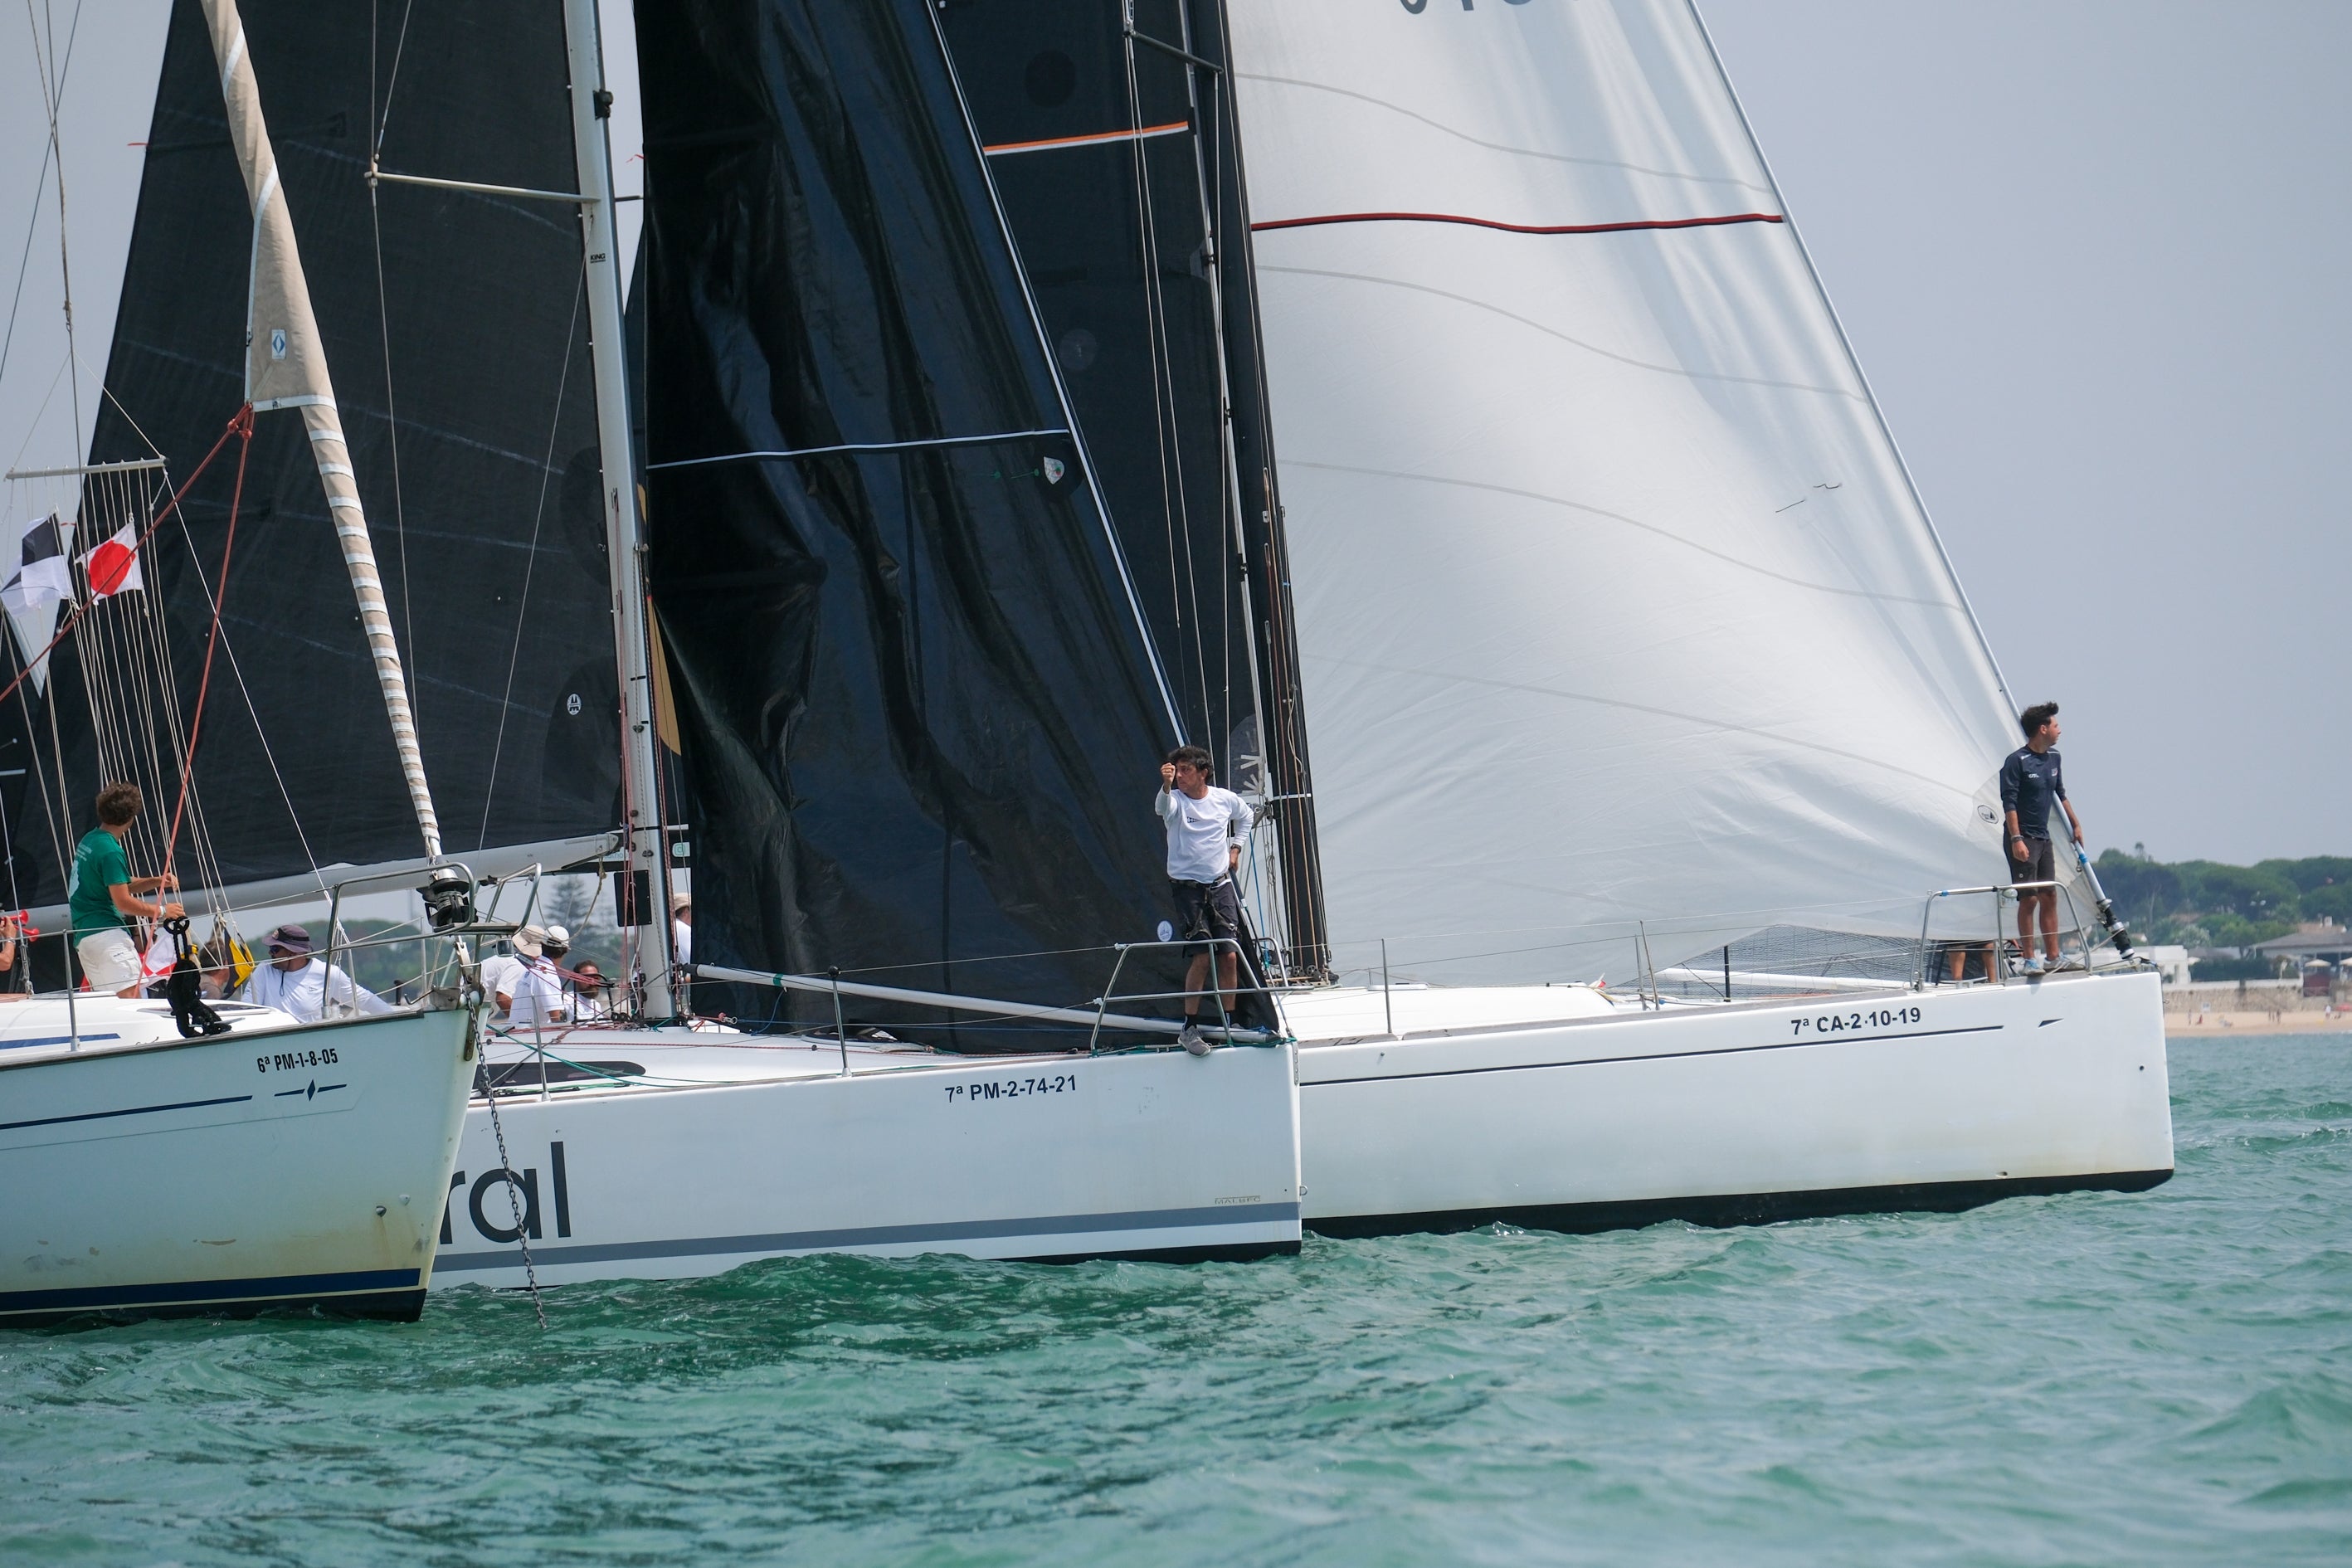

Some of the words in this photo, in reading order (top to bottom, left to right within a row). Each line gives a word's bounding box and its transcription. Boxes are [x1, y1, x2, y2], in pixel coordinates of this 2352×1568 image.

[274, 1048, 338, 1071] PM-1-8-05
[970, 1074, 1077, 1101] PM-2-74-21
[440, 1141, 572, 1244] ral
